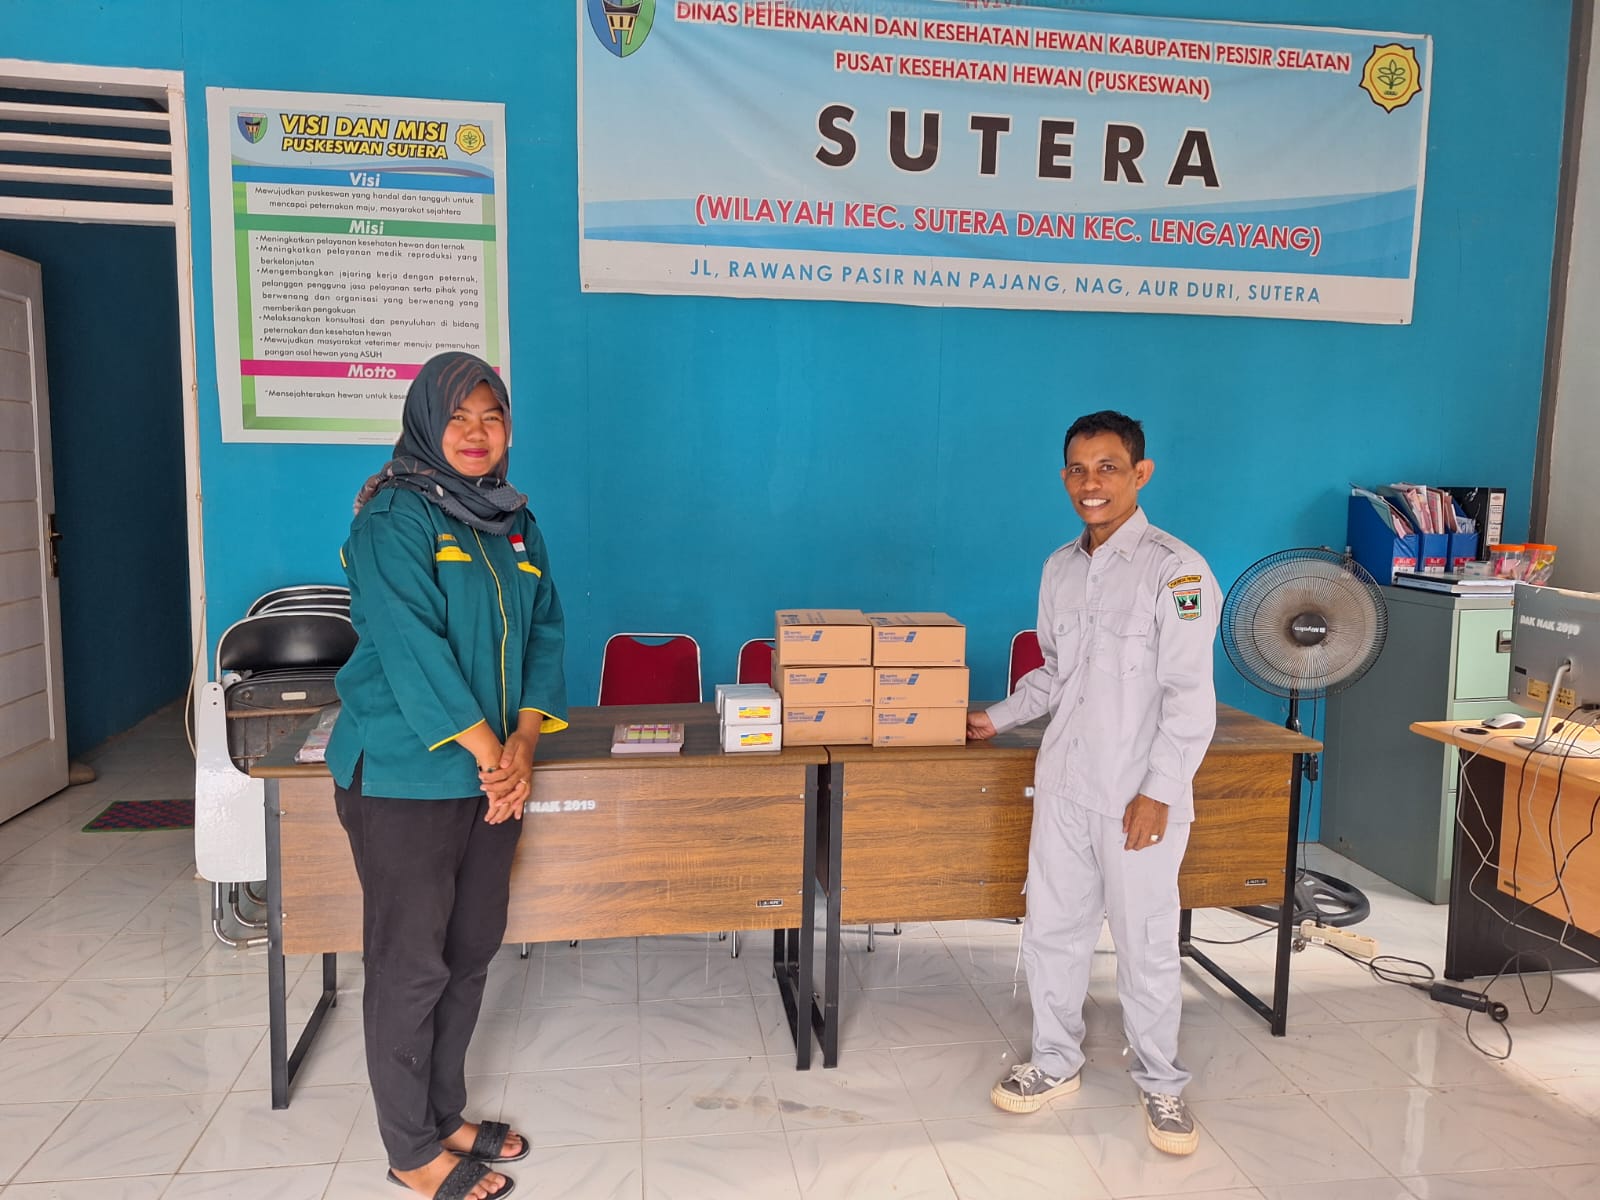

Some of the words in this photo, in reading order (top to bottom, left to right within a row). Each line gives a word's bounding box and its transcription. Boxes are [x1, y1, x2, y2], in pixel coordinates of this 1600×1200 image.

[677, 2, 738, 23] DINAS
[874, 18, 918, 38] DAN
[923, 21, 1029, 49] KESEHATAN
[1035, 31, 1103, 54] HEWAN
[1109, 36, 1211, 63] KABUPATEN
[1215, 45, 1273, 68] PESISIR
[1277, 50, 1351, 73] SELATAN
[836, 52, 894, 73] PUSAT
[899, 57, 1007, 83] KESEHATAN
[1013, 67, 1083, 89] HEWAN
[1087, 70, 1210, 100] (PUSKESWAN)
[279, 114, 328, 136] VISI
[334, 116, 388, 139] DAN
[394, 119, 448, 142] MISI
[282, 138, 384, 156] PUSKESWAN
[386, 142, 448, 160] SUTERA
[815, 104, 1220, 189] SUTERA
[350, 172, 380, 187] Visi
[255, 187, 304, 198] Mewujudkan
[307, 189, 349, 199] puskeswan
[351, 192, 370, 201] yang
[373, 192, 399, 201] handal
[402, 193, 416, 201] dan
[419, 194, 450, 204] tangguh
[453, 196, 474, 204] untuk
[270, 201, 307, 210] mencapai
[310, 202, 353, 211] peternakan
[380, 206, 424, 214] masyarakat
[426, 207, 461, 216] sejahtera
[349, 219, 384, 235] Misi
[695, 193, 834, 227] (WILAYAH
[845, 201, 905, 230] KEC.
[914, 207, 1008, 236] SUTERA
[1017, 214, 1075, 240] DAN
[1084, 217, 1141, 243] KEC.
[1150, 220, 1322, 256] LENGAYANG)
[260, 236, 315, 246] Meningkatkan
[317, 238, 357, 247] pelayanan
[358, 239, 397, 248] kesehatan
[399, 241, 424, 249] hewan
[441, 243, 465, 251] ternak
[260, 245, 321, 255] Meningkatkan
[327, 248, 371, 257] pelayanan
[377, 249, 402, 257] medik
[407, 252, 452, 261] reproduksi
[457, 254, 478, 263] yang
[260, 257, 315, 267] berkelanjutan
[261, 268, 334, 278] Mengembangkan
[339, 270, 372, 280] jejaring
[376, 271, 398, 280] kerja
[403, 272, 434, 281] dengan
[690, 259, 720, 279] JL,
[728, 260, 834, 283] RAWANG
[841, 265, 905, 286] PASIR
[913, 269, 961, 289] NAN
[968, 272, 1067, 296] PAJANG,
[1075, 277, 1129, 297] NAG,
[1138, 279, 1179, 298] AUR
[1186, 281, 1240, 302] DURI,
[1247, 284, 1320, 304] SUTERA
[261, 280, 303, 289] pelanggan
[307, 281, 346, 291] pengguna
[350, 282, 366, 290] jasa
[370, 283, 409, 293] pelayanan
[413, 285, 432, 293] serta
[435, 286, 456, 294] pihak
[460, 288, 478, 297] yang
[262, 292, 309, 302] berwenang
[314, 293, 330, 301] dan
[335, 294, 378, 303] organisasi
[383, 297, 403, 305] yang
[409, 297, 454, 307] berwenang
[459, 299, 479, 308] yang
[263, 304, 312, 313] memberikan
[313, 306, 356, 315] pengakuan
[263, 314, 321, 323] Melaksanakan
[325, 316, 365, 324] konsultasi
[370, 317, 385, 325] dan
[390, 318, 436, 328] penyuluhan
[452, 320, 479, 330] bidang
[263, 327, 308, 336] peternakan
[309, 328, 324, 336] dan
[325, 328, 365, 337] kesehatan
[366, 329, 392, 338] hewan
[263, 336, 314, 346] Mewujudkan
[317, 338, 361, 347] masyarakat
[403, 341, 433, 350] menuju
[435, 342, 480, 351] pemenuhan
[264, 348, 295, 358] pangan
[295, 348, 312, 357] asal
[313, 349, 338, 358] hewan
[340, 351, 359, 359] yang
[360, 350, 382, 359] ASUH
[348, 364, 396, 379] Motto
[338, 391, 363, 400] hewan
[365, 391, 387, 400] untuk
[563, 799, 596, 812] 2019
